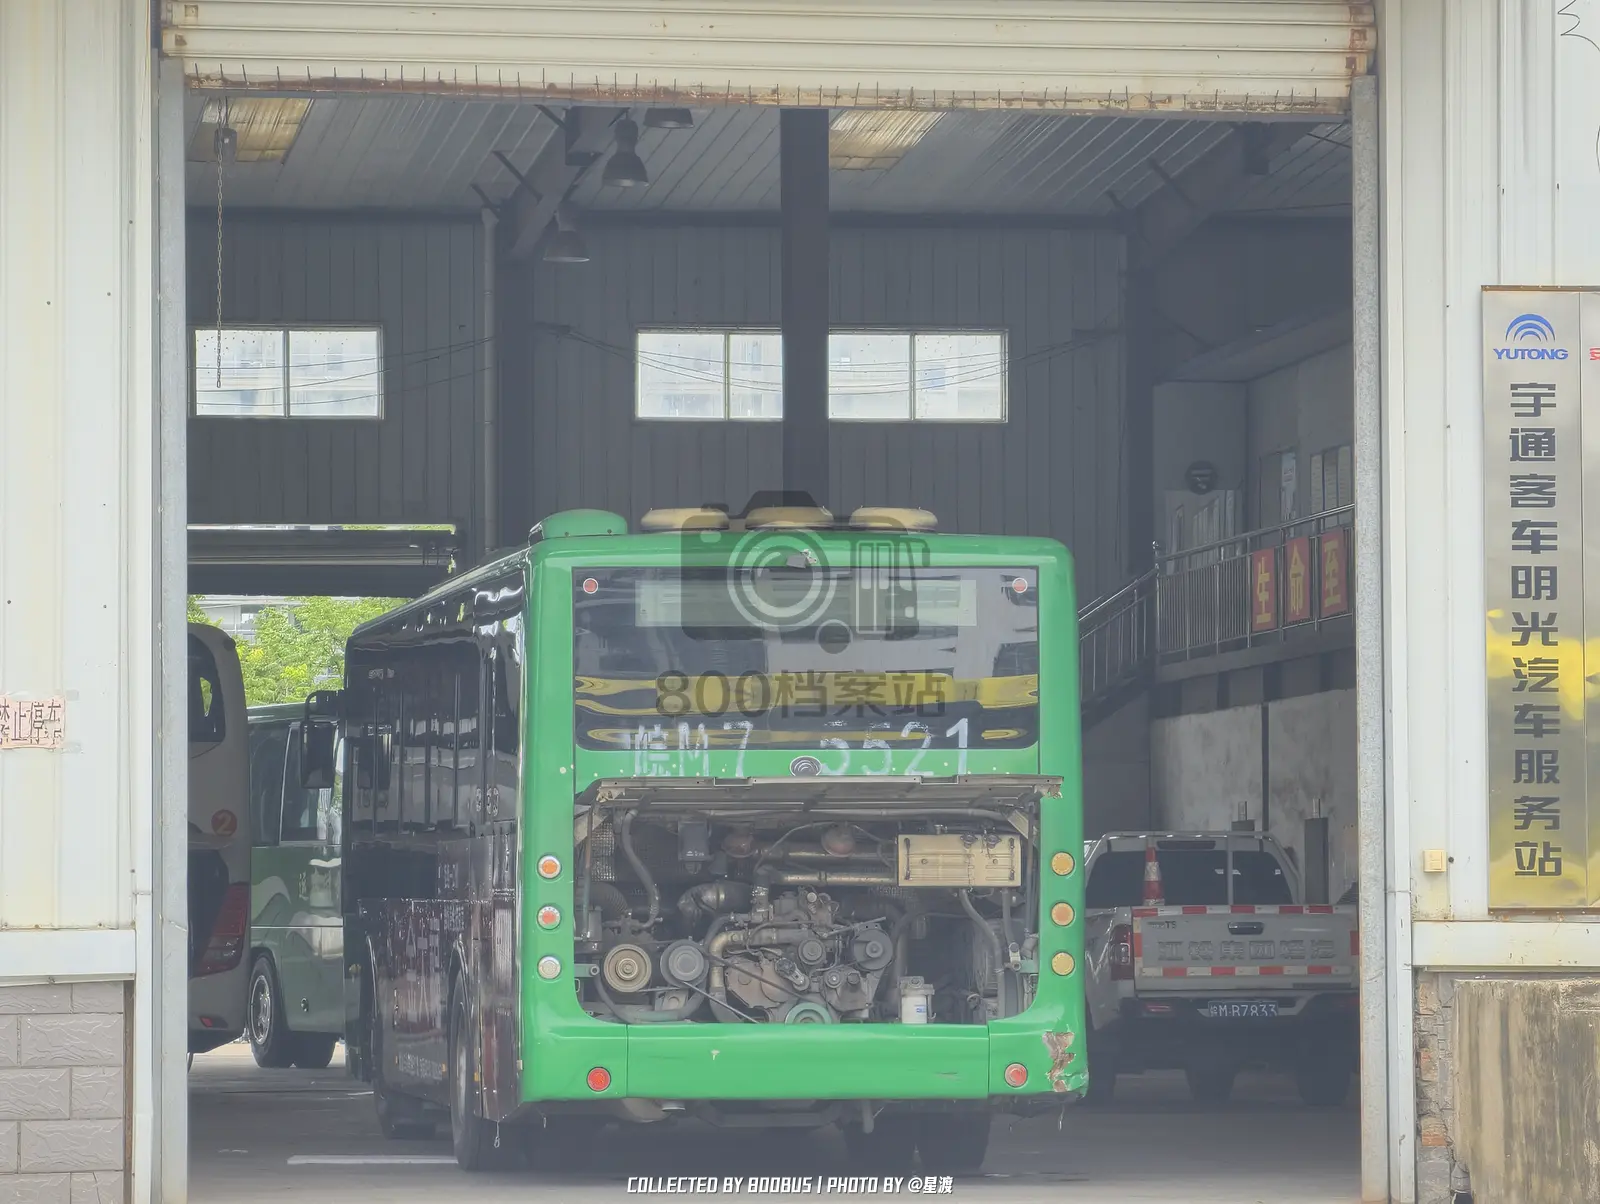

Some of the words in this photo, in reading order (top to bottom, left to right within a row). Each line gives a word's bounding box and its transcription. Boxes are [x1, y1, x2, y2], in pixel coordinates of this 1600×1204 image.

[1494, 348, 1568, 360] YUTONG
[1509, 382, 1562, 877] 宇通客车明光汽车服务站
[216, 811, 232, 834] 2
